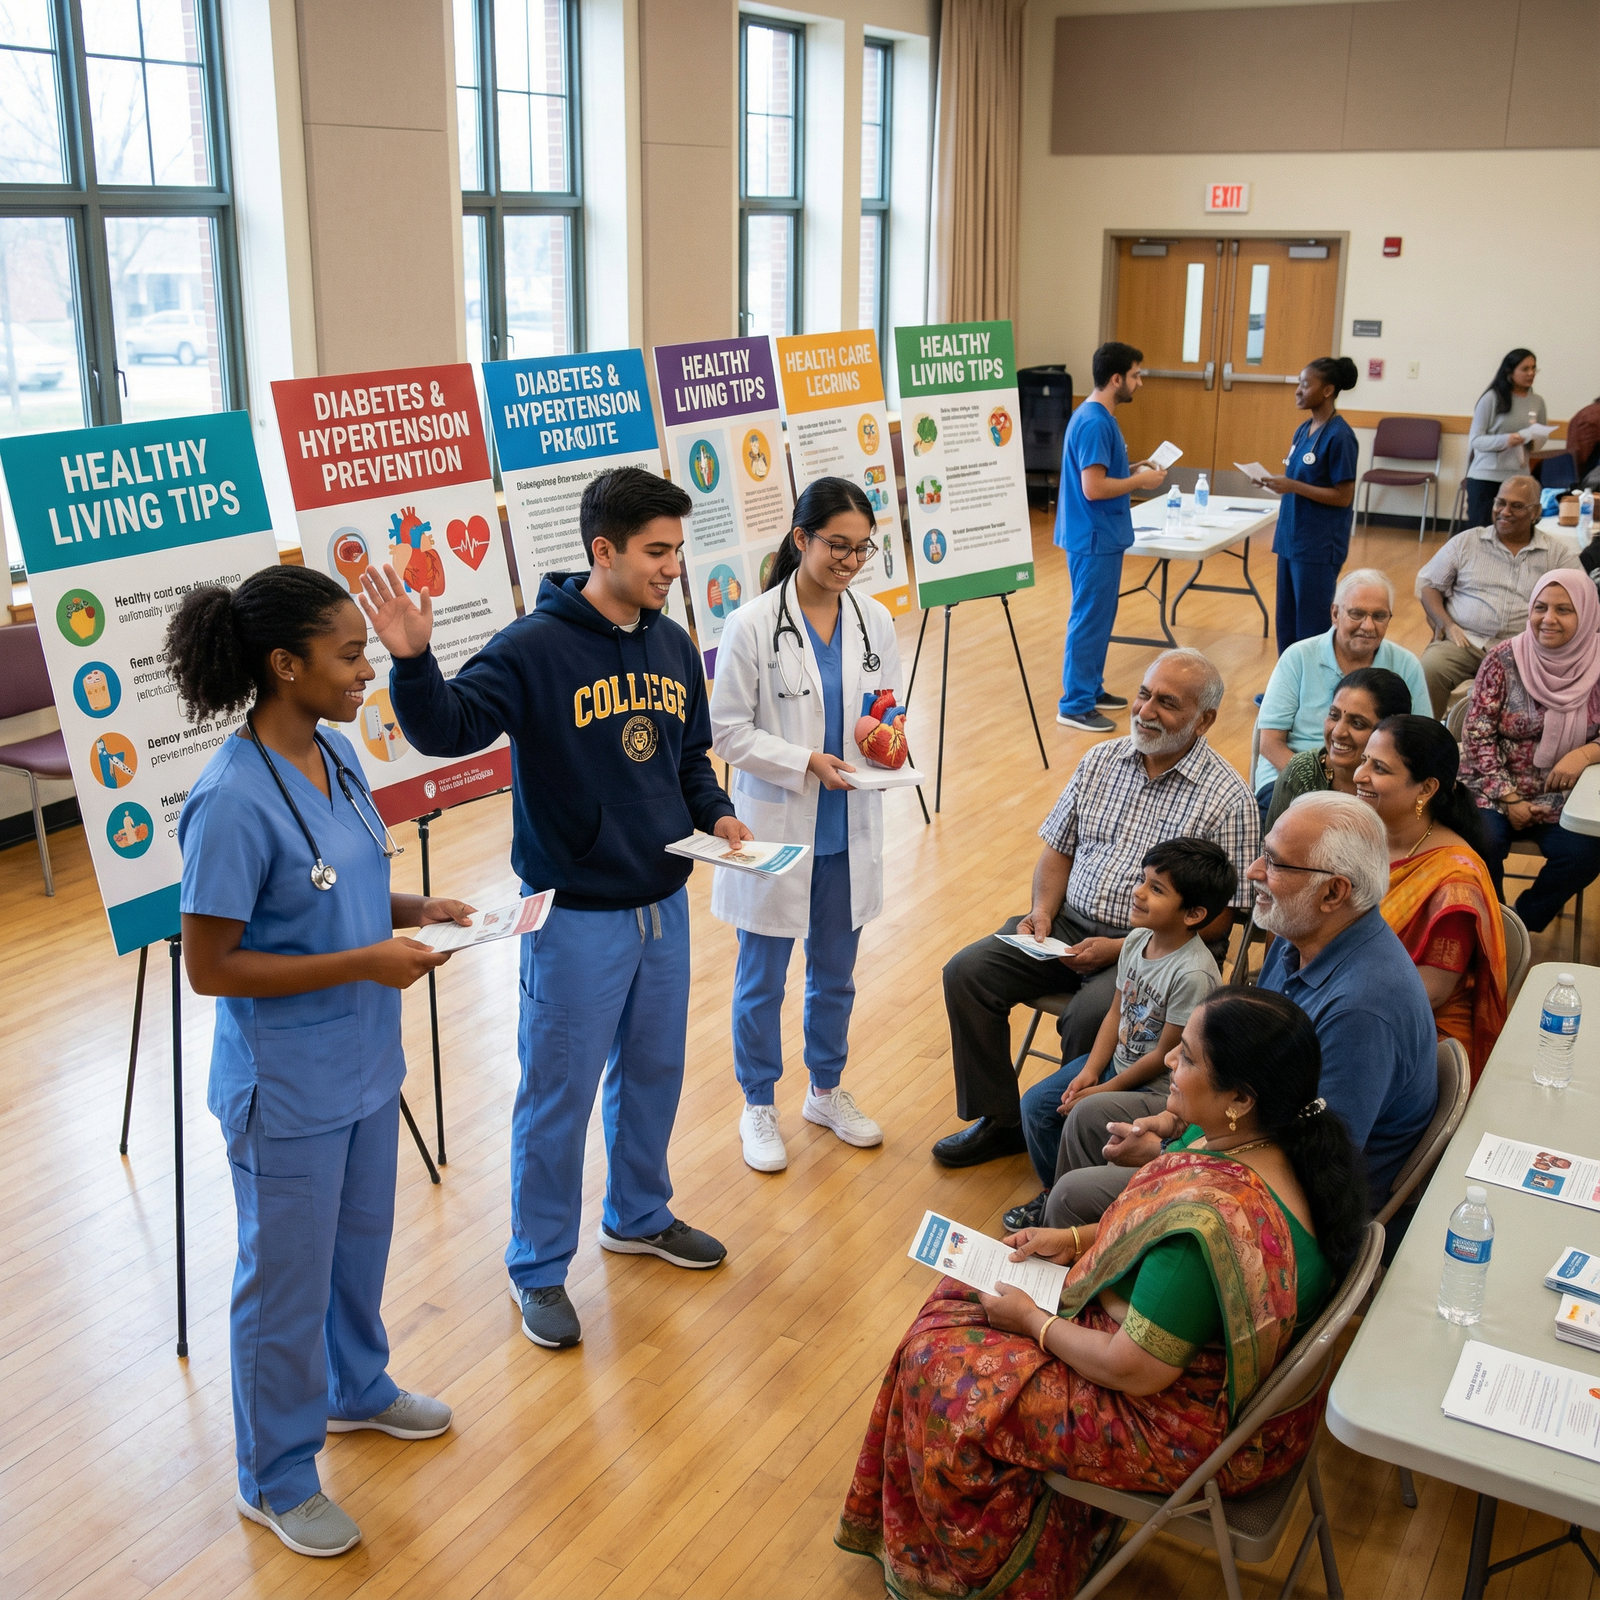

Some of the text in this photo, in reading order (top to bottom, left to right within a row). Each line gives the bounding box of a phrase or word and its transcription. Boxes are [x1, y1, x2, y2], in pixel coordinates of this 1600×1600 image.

[1212, 185, 1243, 209] EXIT
[785, 343, 873, 374] HEALTH CARE
[919, 332, 991, 359] HEALTHY
[515, 363, 621, 398] DIABETES &
[681, 349, 750, 381] HEALTHY
[911, 358, 1004, 387] LIVING TIPS
[313, 380, 447, 422] DIABETES &
[503, 389, 642, 430] HYPERTENSION
[674, 376, 766, 413] LIVING TIPS
[298, 410, 471, 459] HYPERTENSION
[60, 438, 207, 494] HEALTHY
[321, 445, 464, 492] PREVENTION
[48, 480, 241, 546] LIVING TIPS
[114, 591, 151, 608] Healthy
[573, 672, 687, 728] COLLEGE
